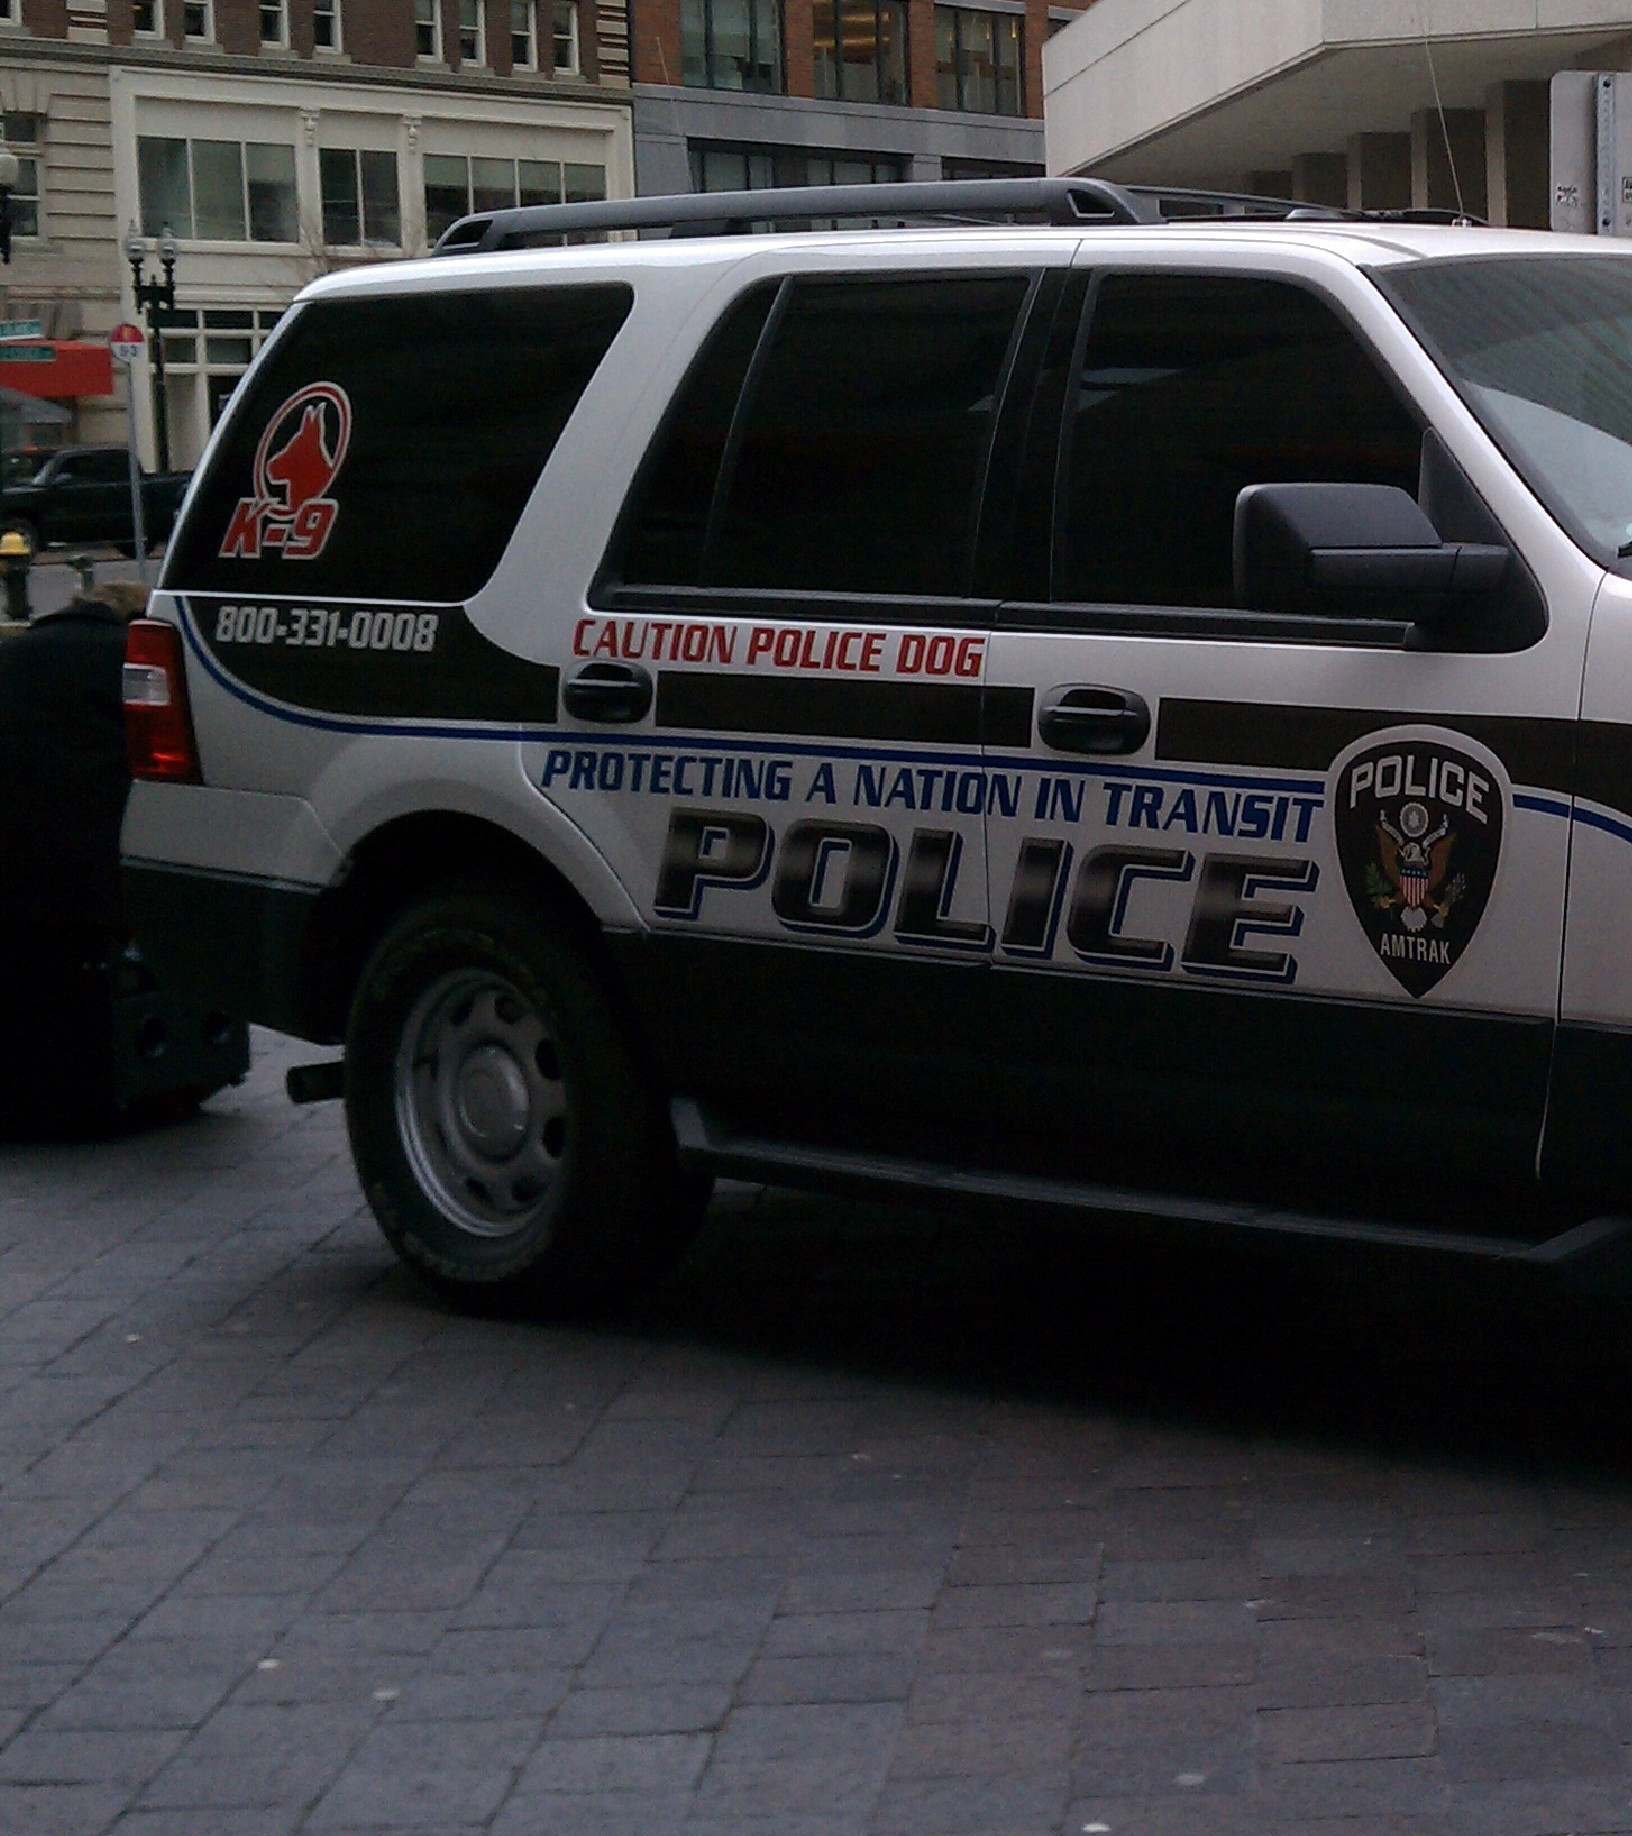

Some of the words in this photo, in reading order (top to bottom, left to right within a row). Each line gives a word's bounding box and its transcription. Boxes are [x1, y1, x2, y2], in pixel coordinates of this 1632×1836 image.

[218, 497, 340, 560] K-9
[215, 605, 440, 652] 800-331-0008
[573, 619, 738, 663] CAUTION
[747, 627, 887, 673] POLICE
[896, 634, 986, 678] DOG
[541, 750, 794, 801] PROTECTING
[805, 763, 837, 805] A
[853, 765, 1022, 818] NATION
[1034, 778, 1086, 823] IN
[1103, 782, 1325, 843] TRANSIT
[1350, 754, 1490, 825] POLICE
[652, 805, 1321, 984] POLICE
[1380, 933, 1450, 965] AMTRAK
